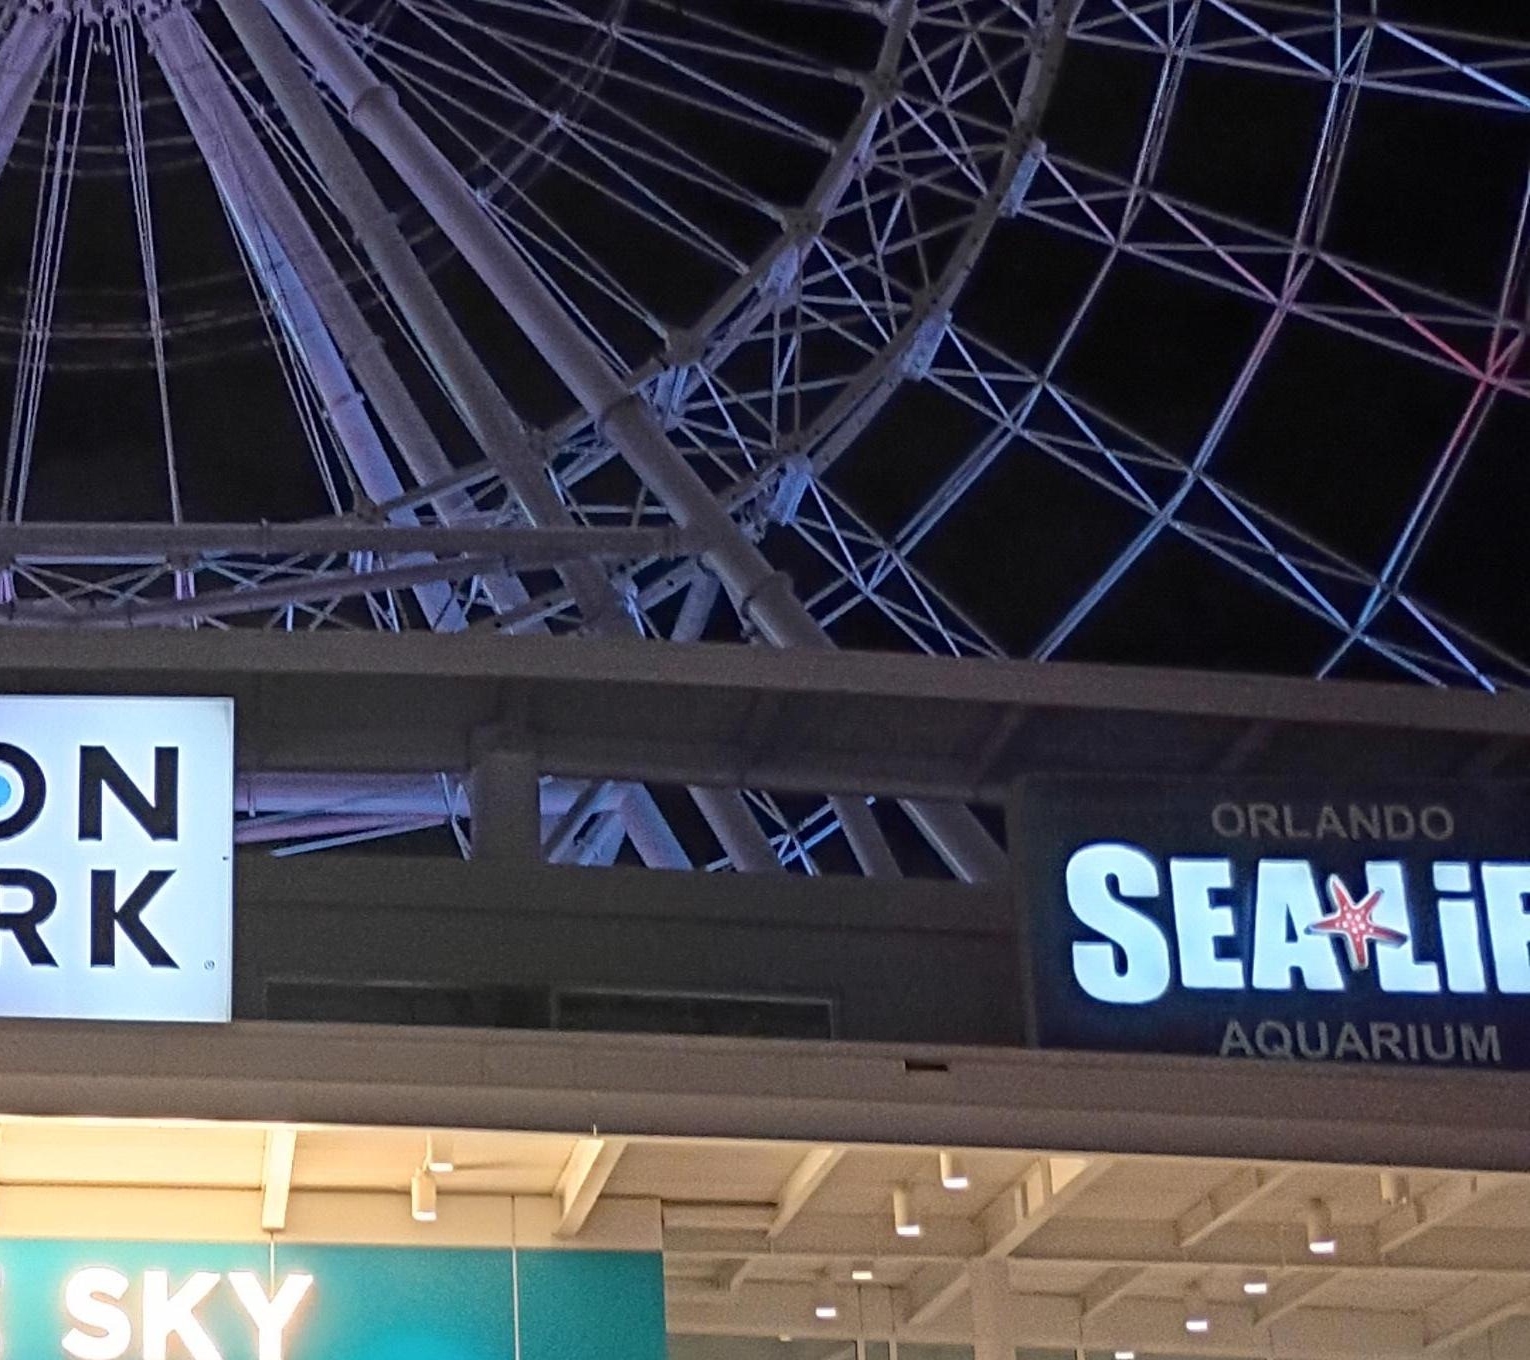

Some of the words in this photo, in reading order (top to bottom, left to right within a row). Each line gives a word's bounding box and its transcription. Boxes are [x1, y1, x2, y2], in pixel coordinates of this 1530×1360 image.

[1211, 801, 1455, 842] ORLANDO
[1065, 842, 1346, 1005] SEA
[1219, 1019, 1502, 1063] AQUARIUM
